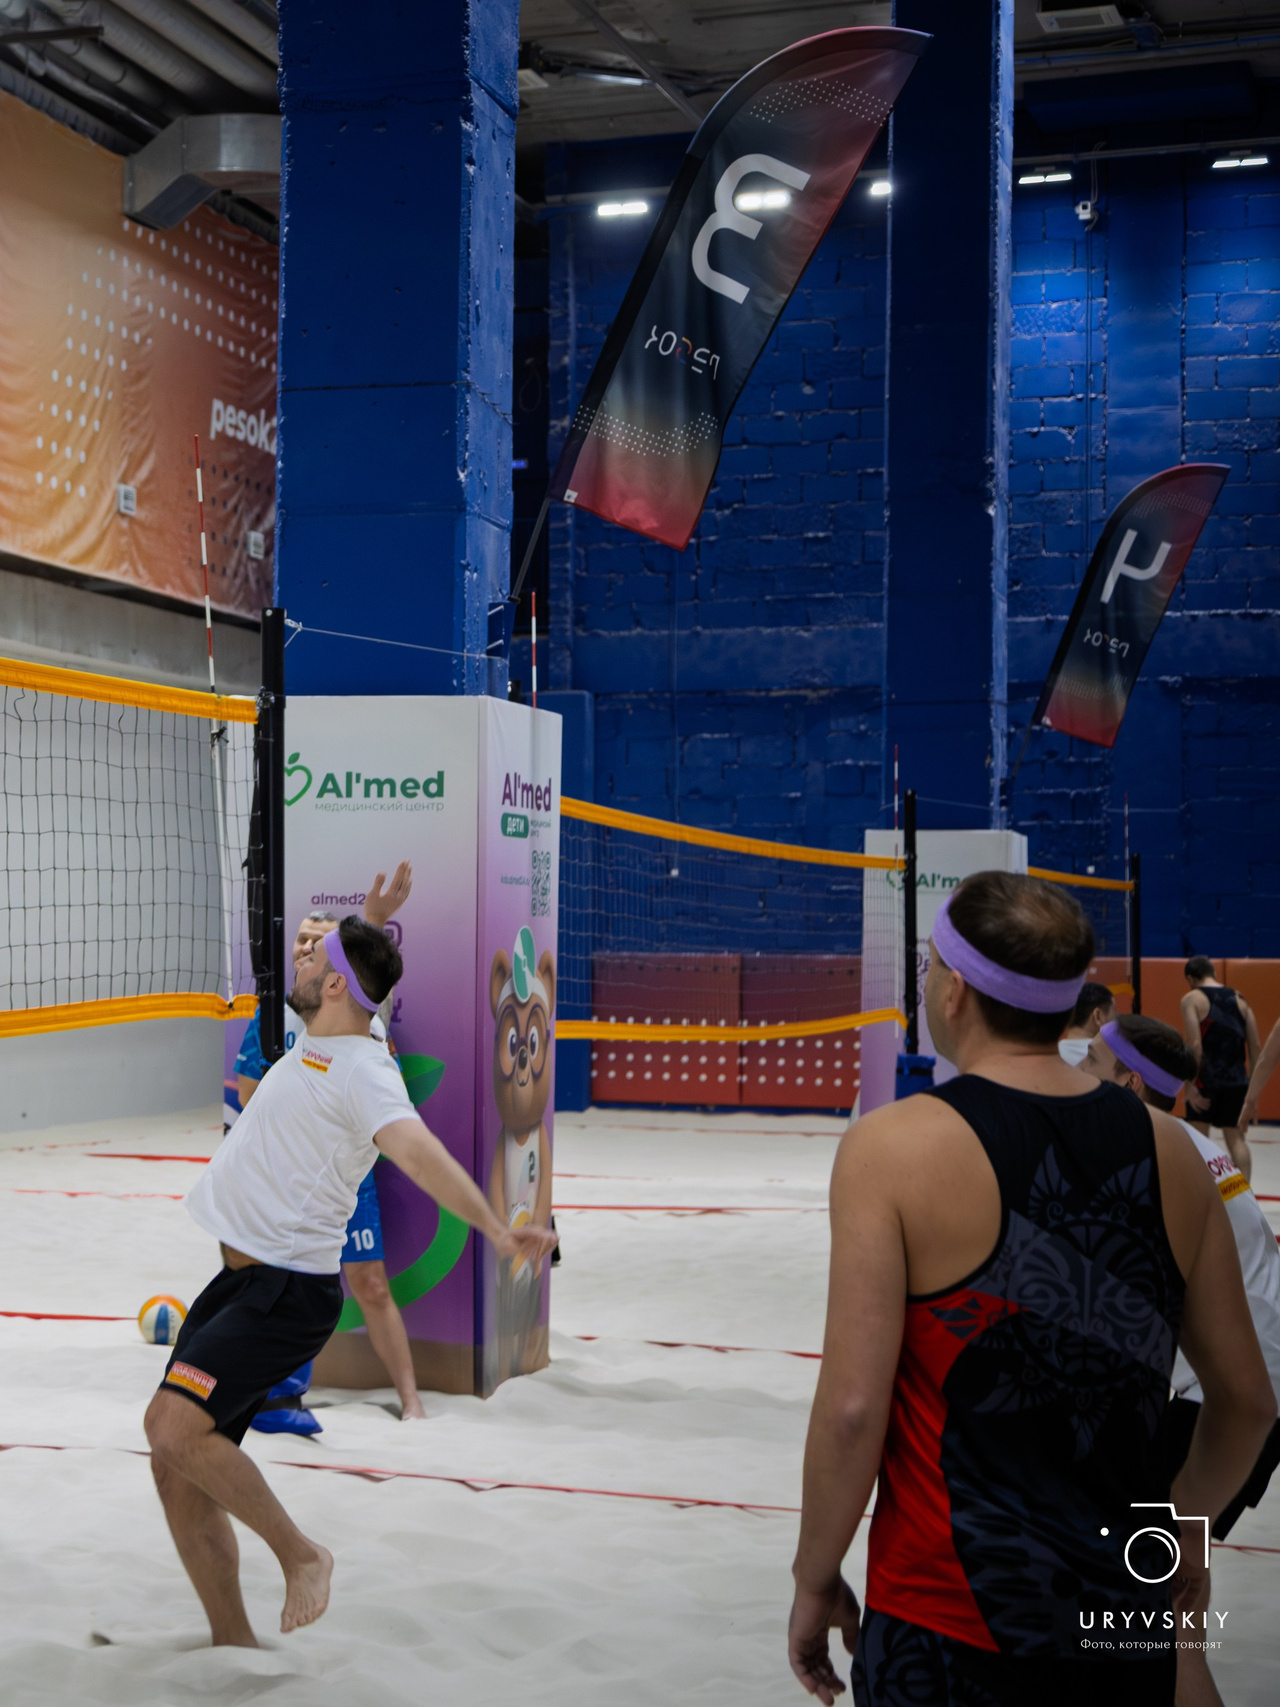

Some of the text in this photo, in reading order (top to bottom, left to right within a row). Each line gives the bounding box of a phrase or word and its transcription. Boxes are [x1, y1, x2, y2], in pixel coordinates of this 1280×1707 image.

[316, 770, 445, 798] Al'med
[502, 772, 552, 812] Al'med
[315, 801, 445, 812] медицинский центр
[916, 872, 961, 888] Al'm
[351, 1228, 375, 1252] 10
